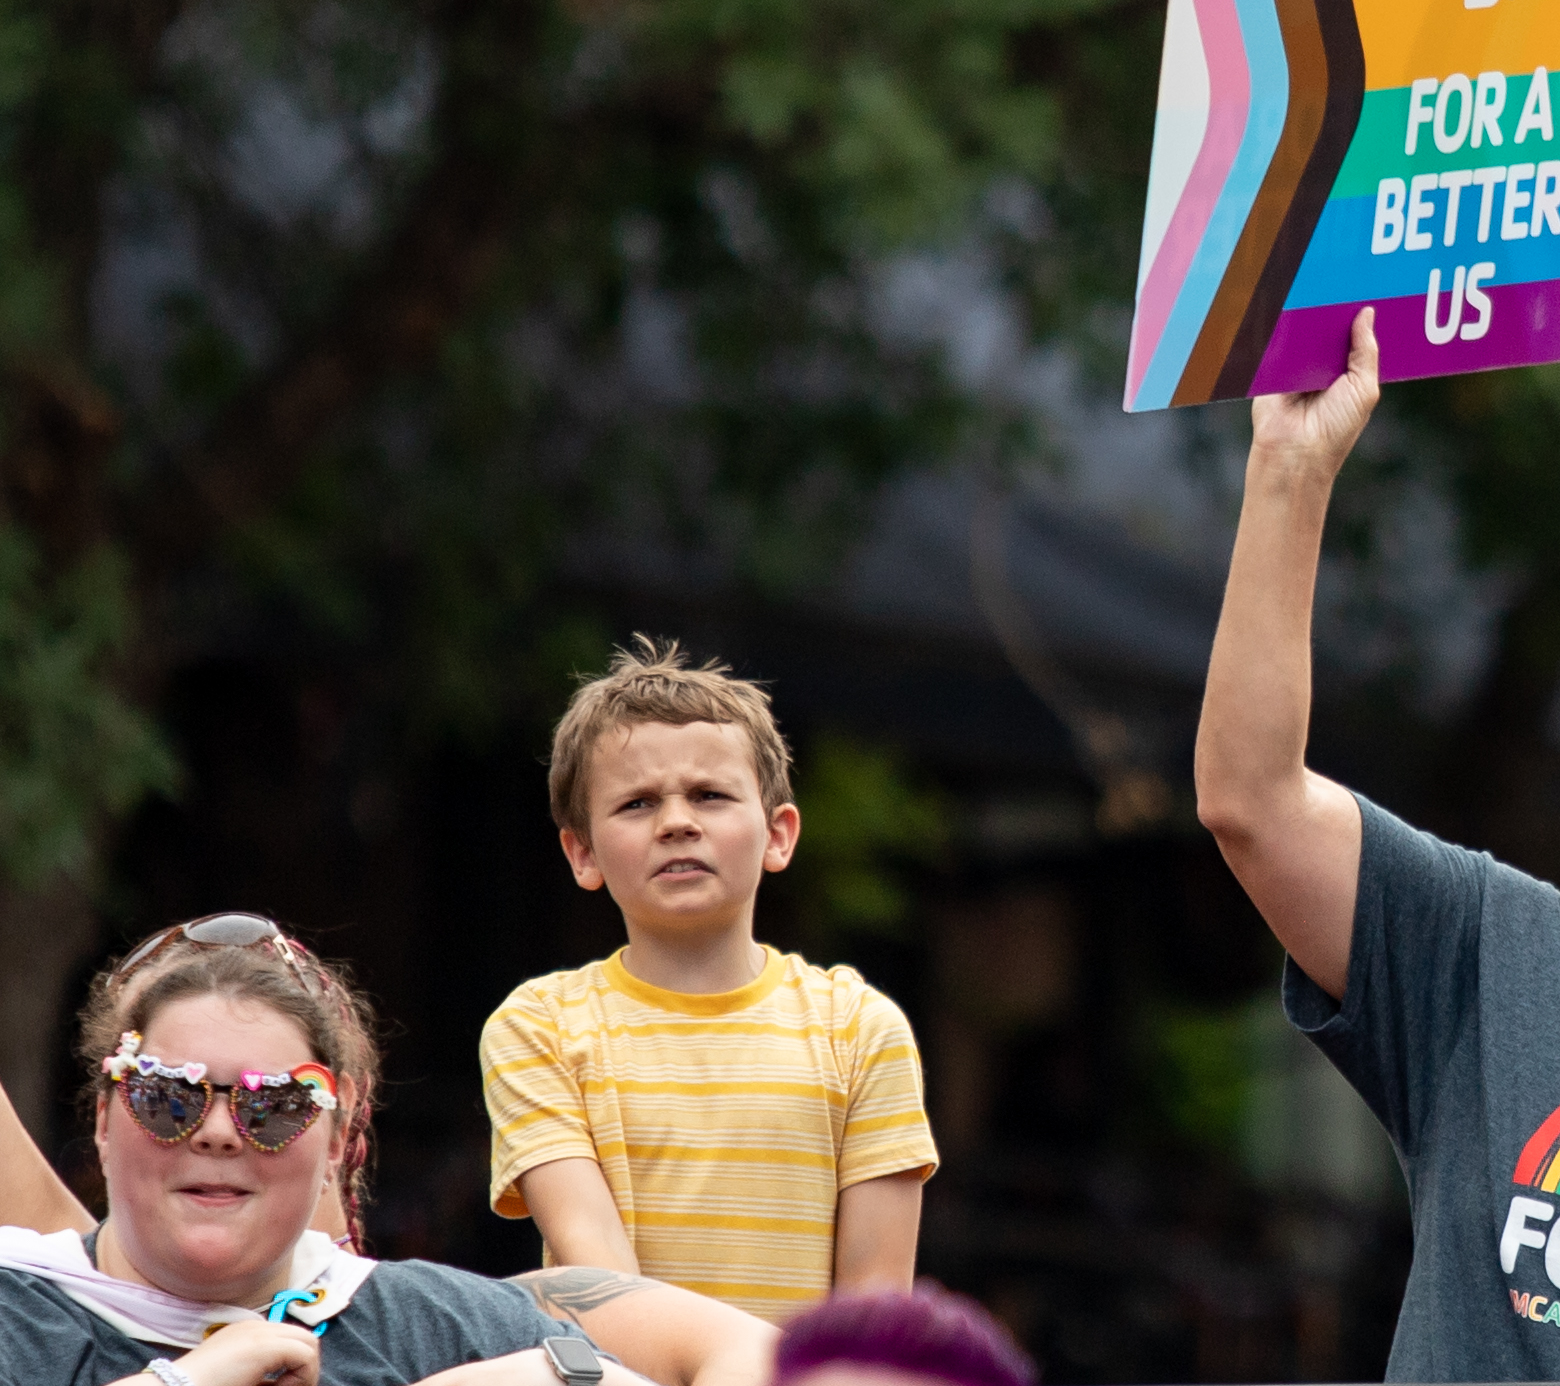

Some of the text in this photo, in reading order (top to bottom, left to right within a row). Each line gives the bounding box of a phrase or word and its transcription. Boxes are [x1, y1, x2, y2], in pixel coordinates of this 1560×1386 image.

[1404, 66, 1554, 155] FOR A
[1424, 262, 1496, 345] US
